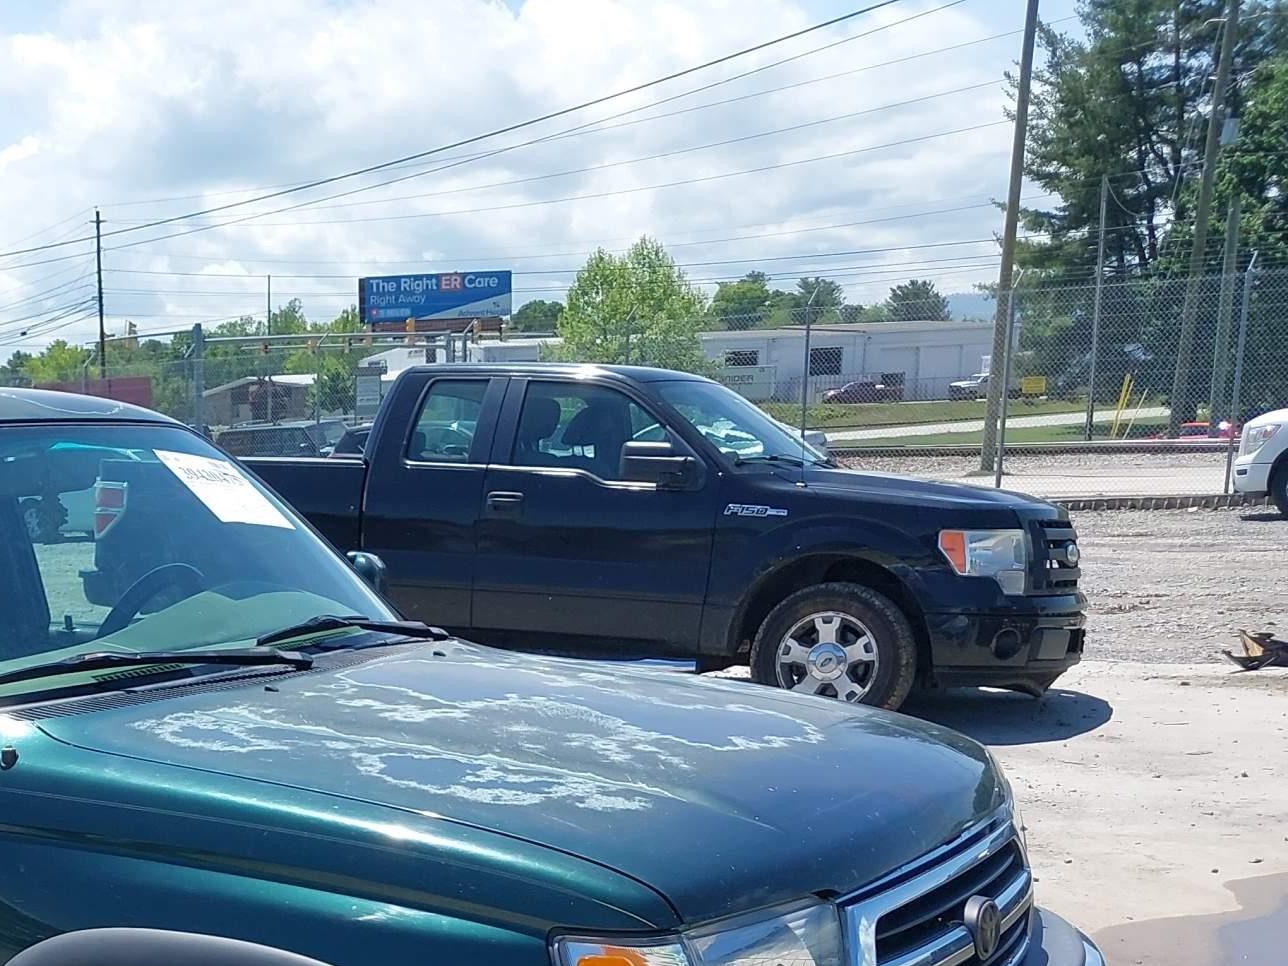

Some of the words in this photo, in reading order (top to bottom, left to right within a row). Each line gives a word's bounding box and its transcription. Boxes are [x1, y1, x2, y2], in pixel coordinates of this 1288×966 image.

[369, 279, 397, 293] The
[401, 277, 437, 294] Right
[441, 276, 461, 289] ER
[464, 275, 499, 289] Care
[370, 295, 396, 305] Right
[398, 294, 426, 305] Away
